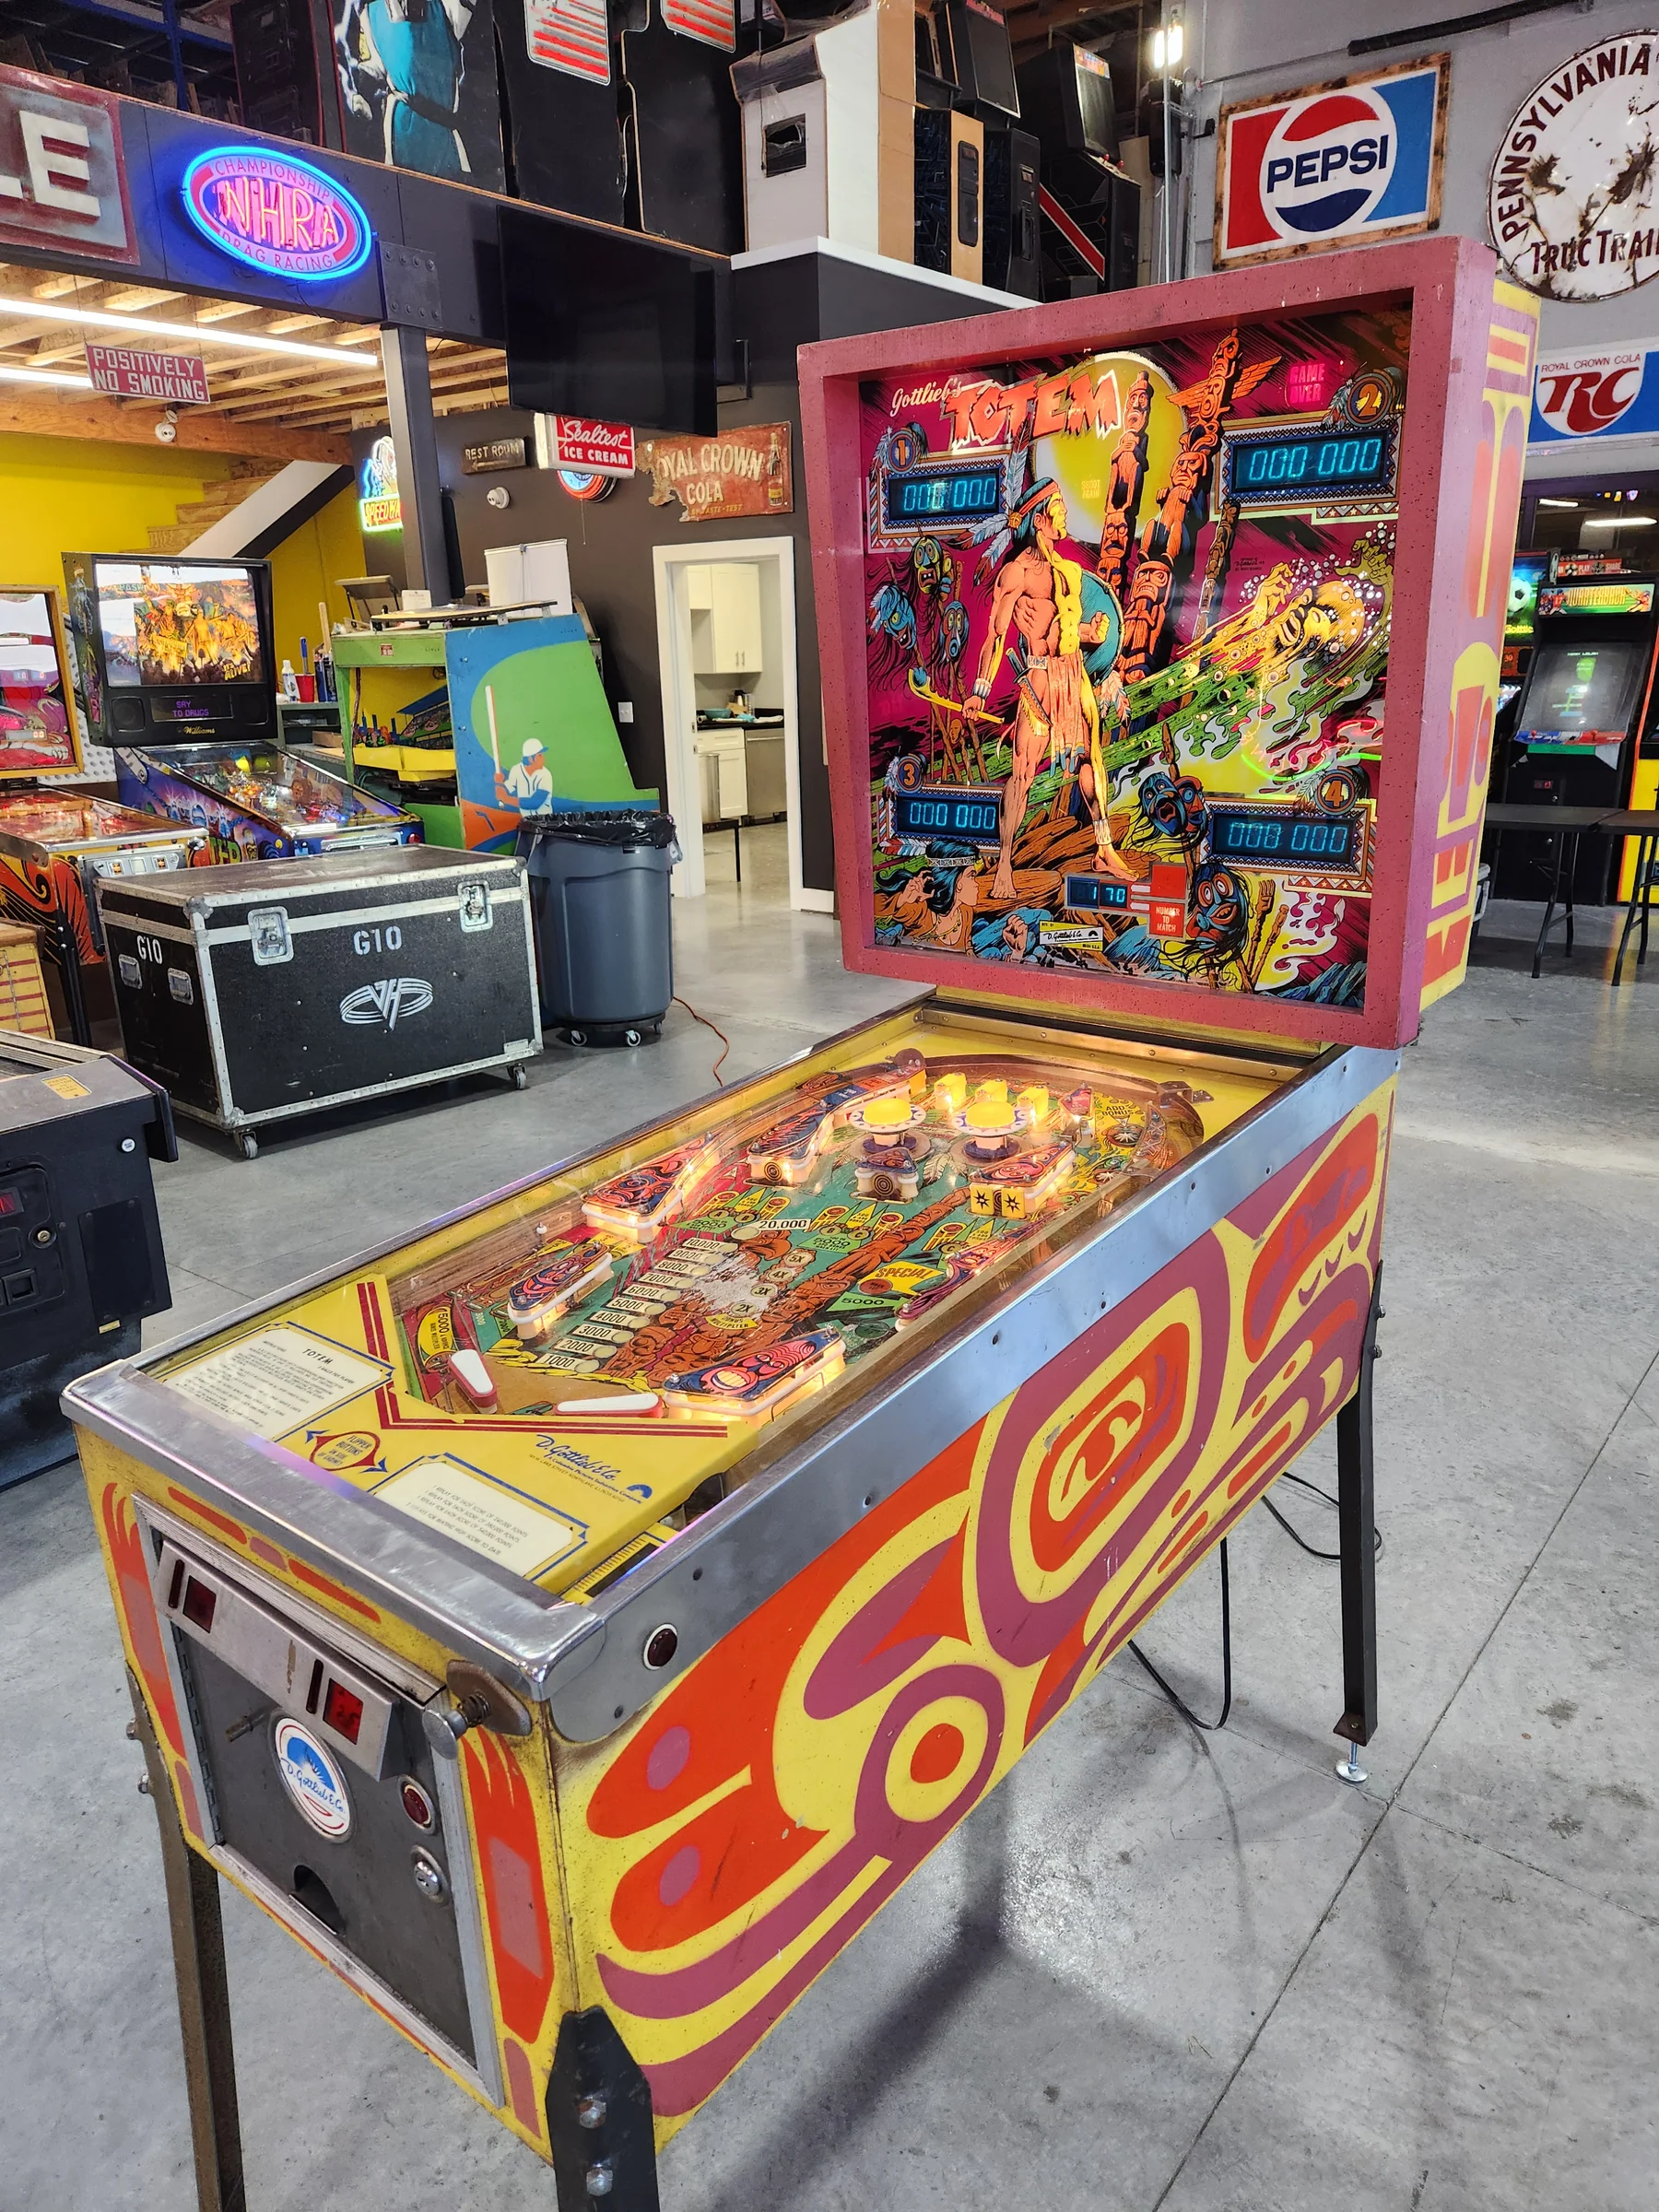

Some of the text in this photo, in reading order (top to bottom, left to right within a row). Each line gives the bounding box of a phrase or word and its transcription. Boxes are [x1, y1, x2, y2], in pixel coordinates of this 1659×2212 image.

[1498, 43, 1651, 243] PENNSYLVANIA
[1266, 135, 1389, 193] PEPSI
[215, 159, 331, 200] CHAMPIONSHIP
[214, 176, 340, 249] NHRA
[222, 229, 333, 271] DRAG RACING
[92, 347, 195, 377] POSITIVELY
[1541, 354, 1641, 372] ROYAL CROWN COLA
[1290, 364, 1324, 382] GAME
[94, 369, 205, 400] NO SMOKING
[1290, 383, 1322, 404] OVER
[890, 378, 962, 417] Gottlieb's
[1358, 383, 1379, 417] 2
[1540, 367, 1640, 432] RC
[944, 370, 1122, 450] TOTEM
[562, 419, 632, 449] Sealtest
[465, 442, 519, 461] REST ROOM
[564, 446, 629, 465] ICE CREAM
[897, 440, 907, 465] 1
[1318, 439, 1382, 476] 000
[656, 443, 764, 481] OYAL CROWN
[687, 480, 724, 505] COLA
[953, 477, 996, 508] 000
[171, 709, 209, 718] TO DRUGS
[176, 700, 192, 709] SAY
[183, 725, 216, 735] Williams
[904, 763, 915, 786] 3
[1324, 780, 1344, 807] 4
[910, 802, 996, 830] 000 000
[1291, 824, 1347, 853] 000
[1106, 887, 1126, 903] 70
[1157, 924, 1176, 933] MATCH
[1162, 916, 1171, 924] TO
[137, 935, 163, 965] G10
[353, 925, 403, 956] G10
[759, 1218, 807, 1230] 20,000
[813, 1237, 851, 1247] 5000
[658, 1260, 688, 1272] 8000
[789, 1254, 805, 1264] 5X
[643, 1273, 674, 1285] 7000
[771, 1271, 788, 1280] 4X
[875, 1267, 934, 1280] SPECIAL
[628, 1285, 658, 1298] 6000
[754, 1287, 772, 1297] 3X
[612, 1298, 644, 1311] 5000
[735, 1304, 752, 1313] 2X
[841, 1297, 885, 1306] 5000
[438, 1312, 450, 1334] 5000
[595, 1311, 628, 1324] 4000
[579, 1324, 612, 1338] 3000
[562, 1338, 594, 1353] 2000
[302, 1347, 335, 1366] TOTEM
[545, 1353, 576, 1368] 1000
[335, 1441, 363, 1455] BUTTONS
[347, 1435, 372, 1449] FLIPPER
[544, 1445, 603, 1469] Gottlieb
